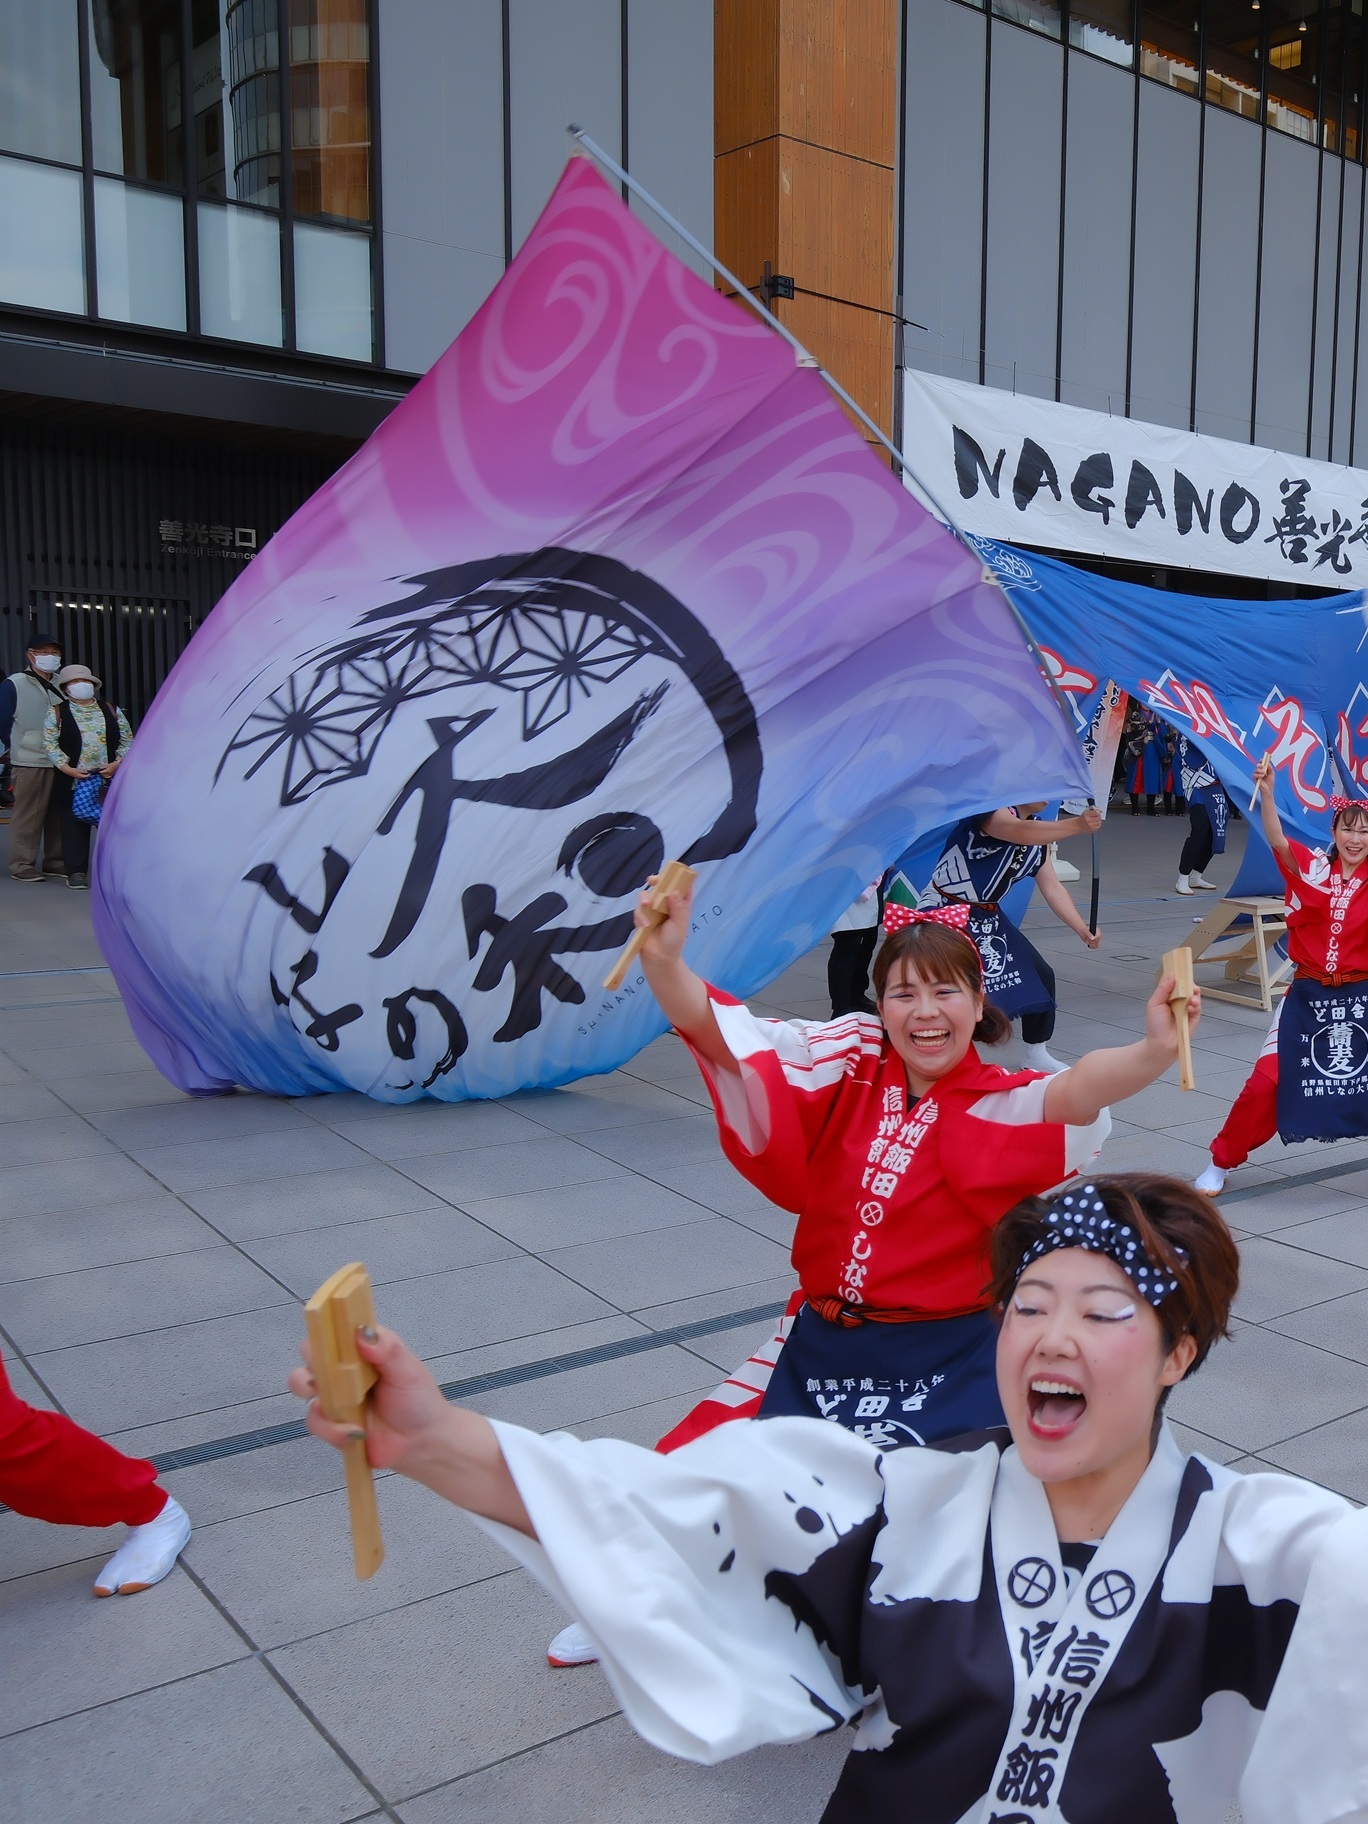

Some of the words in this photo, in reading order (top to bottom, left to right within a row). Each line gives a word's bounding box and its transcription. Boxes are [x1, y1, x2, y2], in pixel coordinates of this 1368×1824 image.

[158, 519, 257, 549] 善光寺口
[207, 548, 257, 560] Entrance
[1314, 1003, 1365, 1022] ど田舎
[1326, 1022, 1355, 1073] 蕎麦
[870, 1097, 939, 1199] 信州飯田
[843, 1231, 872, 1304] しなの
[806, 1374, 945, 1392] 創業平成二十八年
